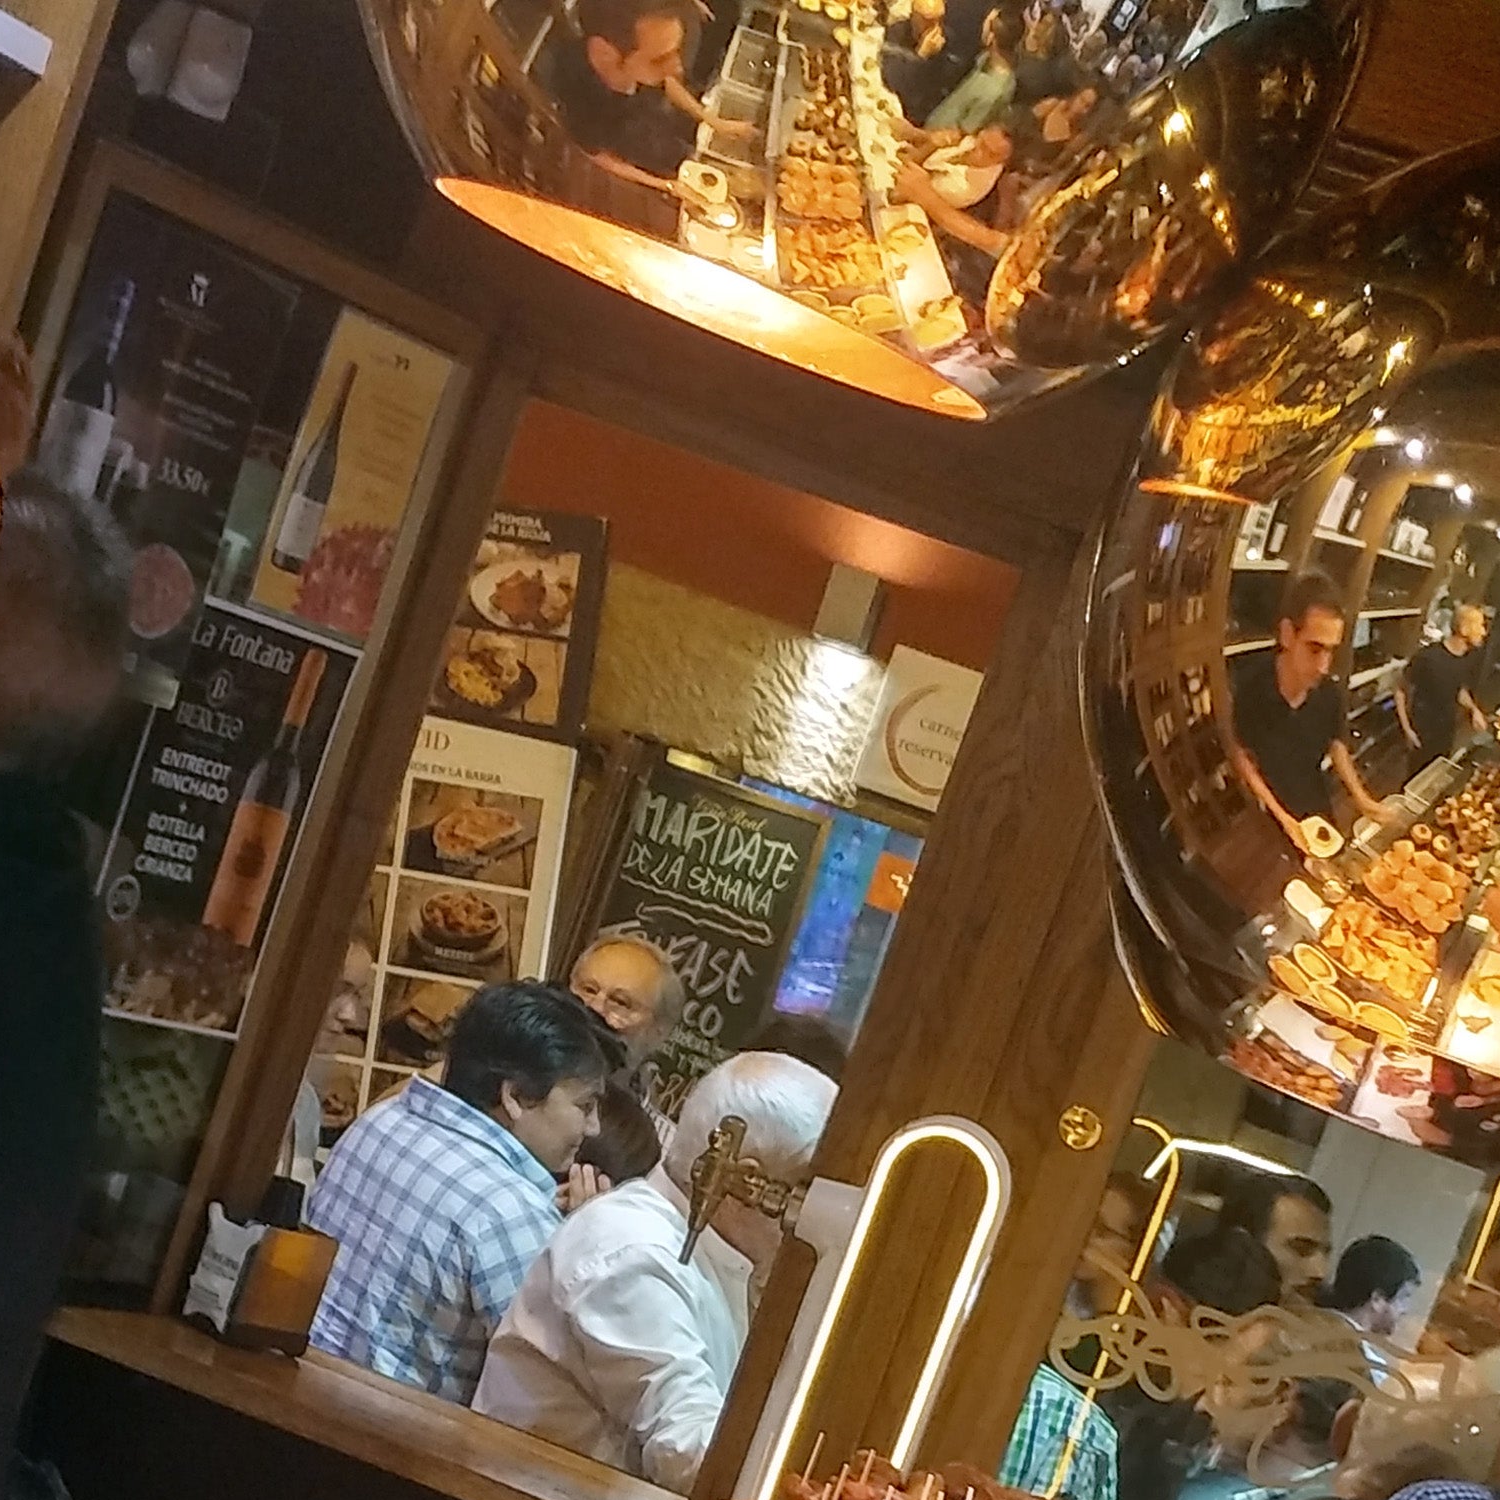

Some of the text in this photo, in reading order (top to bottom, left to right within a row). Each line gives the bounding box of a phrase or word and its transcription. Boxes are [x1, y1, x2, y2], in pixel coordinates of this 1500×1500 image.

[191, 616, 296, 675] La Fontana
[160, 746, 233, 781] ENTRECOT
[151, 767, 230, 805] TRINCHADO
[146, 811, 206, 843] BOTELLA
[635, 788, 799, 890] MARIDAJE
[143, 834, 199, 863] BERCEO
[133, 853, 194, 884] CRIANZA
[621, 840, 774, 917] DE LA SEMANA
